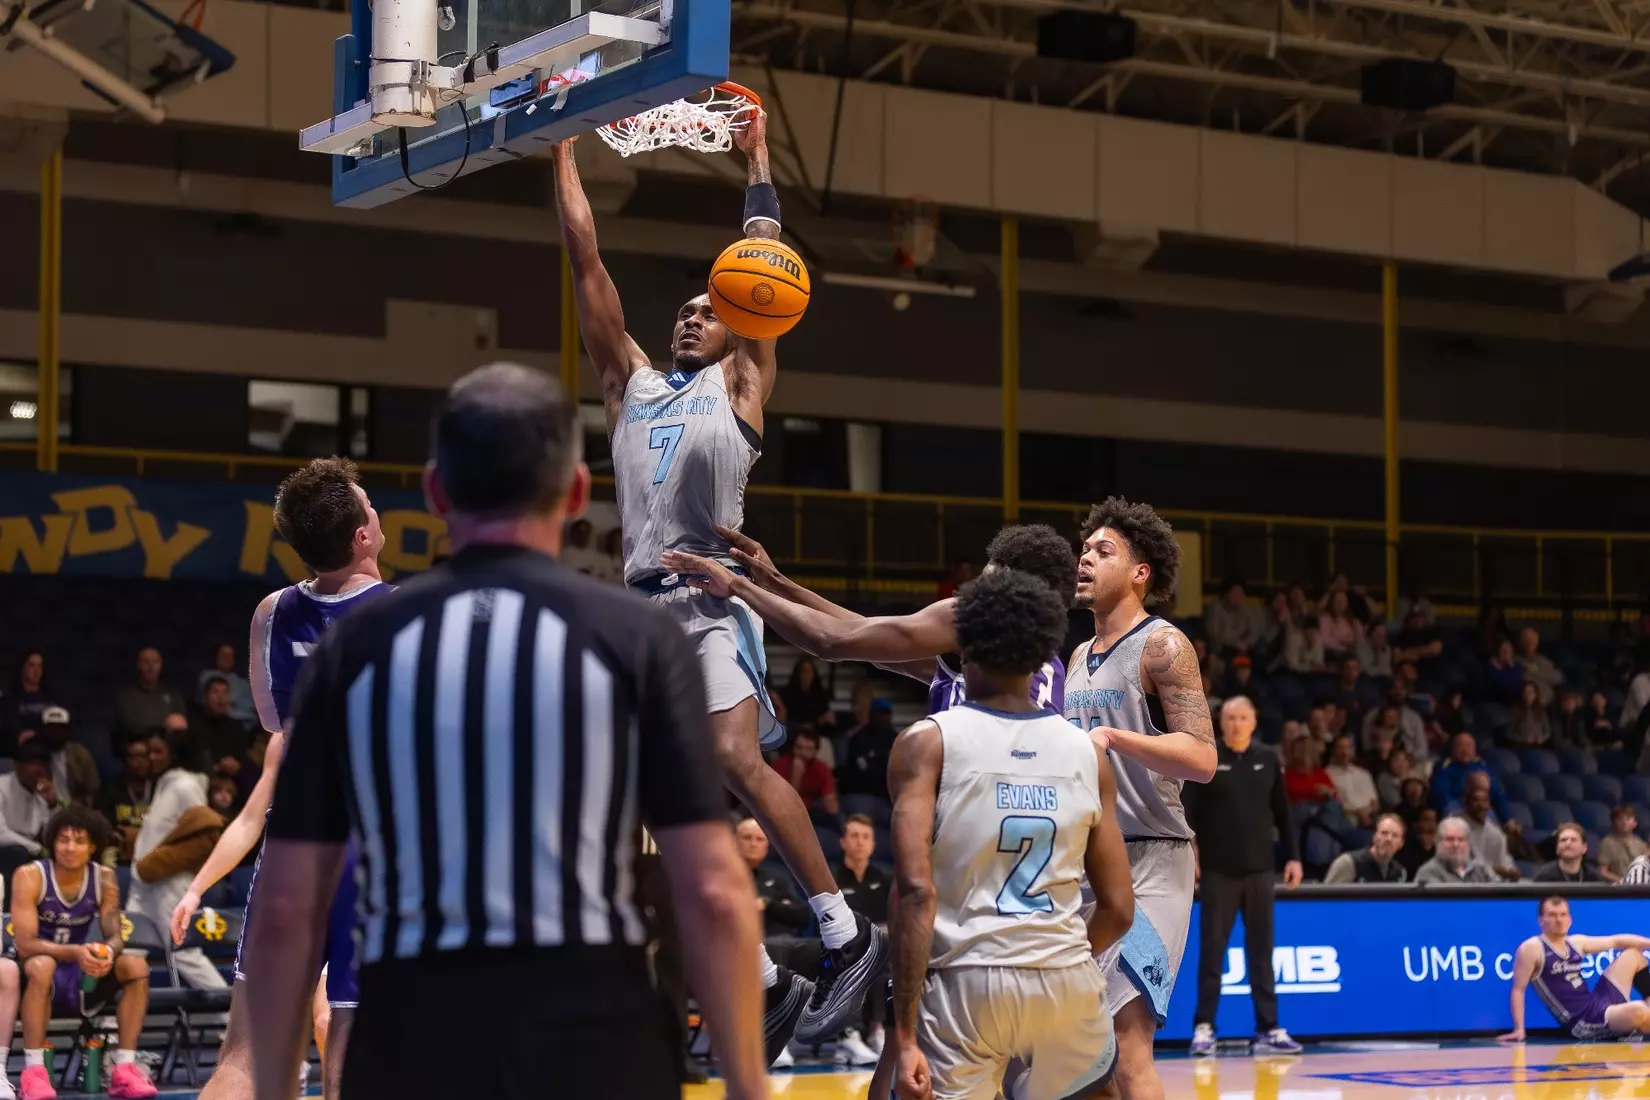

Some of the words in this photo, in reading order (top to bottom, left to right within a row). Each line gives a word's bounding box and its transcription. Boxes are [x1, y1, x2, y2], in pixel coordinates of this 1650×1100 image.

[737, 248, 801, 281] Wilson
[686, 395, 718, 416] CITY
[649, 423, 685, 486] 7
[996, 782, 1058, 812] EVANS
[995, 815, 1057, 915] 2
[1402, 944, 1485, 982] UMB
